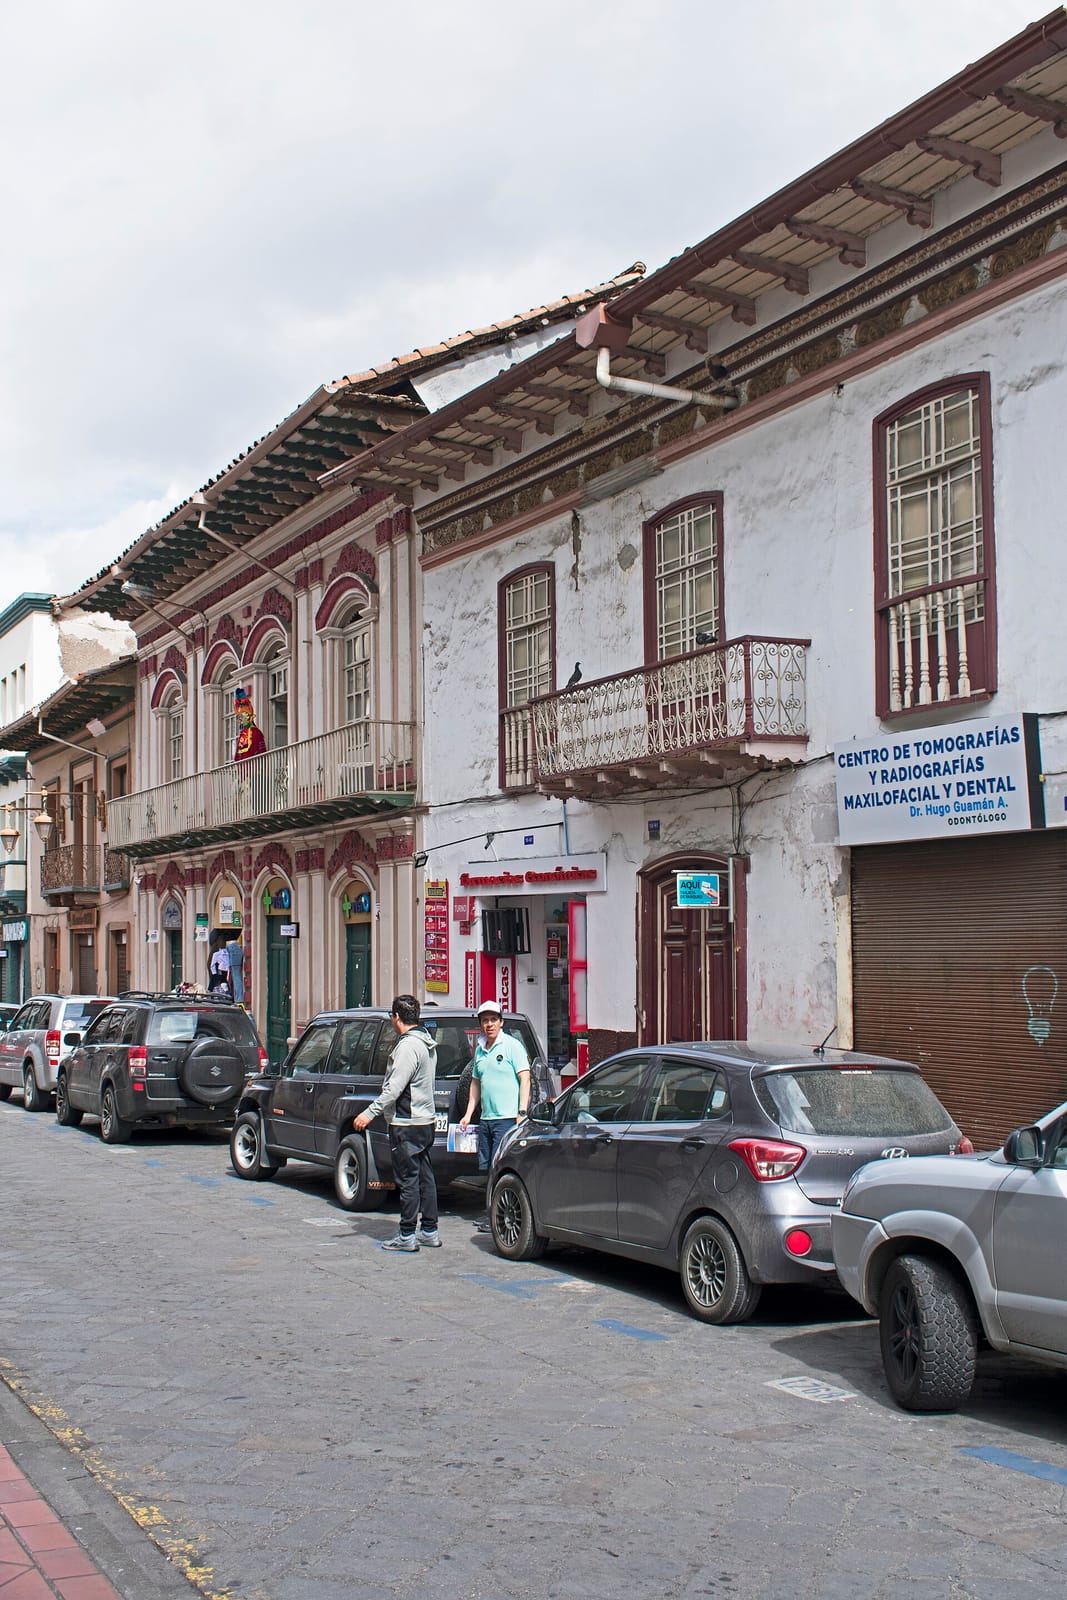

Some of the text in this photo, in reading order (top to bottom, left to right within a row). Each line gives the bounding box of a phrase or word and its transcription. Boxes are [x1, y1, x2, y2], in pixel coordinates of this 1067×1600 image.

[838, 725, 1020, 769] CENTRO DE TOMOGRAFÍAS
[868, 755, 985, 786] Y RADIOGRAFÍAS
[844, 775, 1016, 810] MAXILOFACIAL Y DENTAL
[910, 798, 1008, 817] Dr. Hugo Guamán A.
[948, 812, 1007, 826] ODONTÓLOGO
[680, 880, 700, 890] AQUÍ
